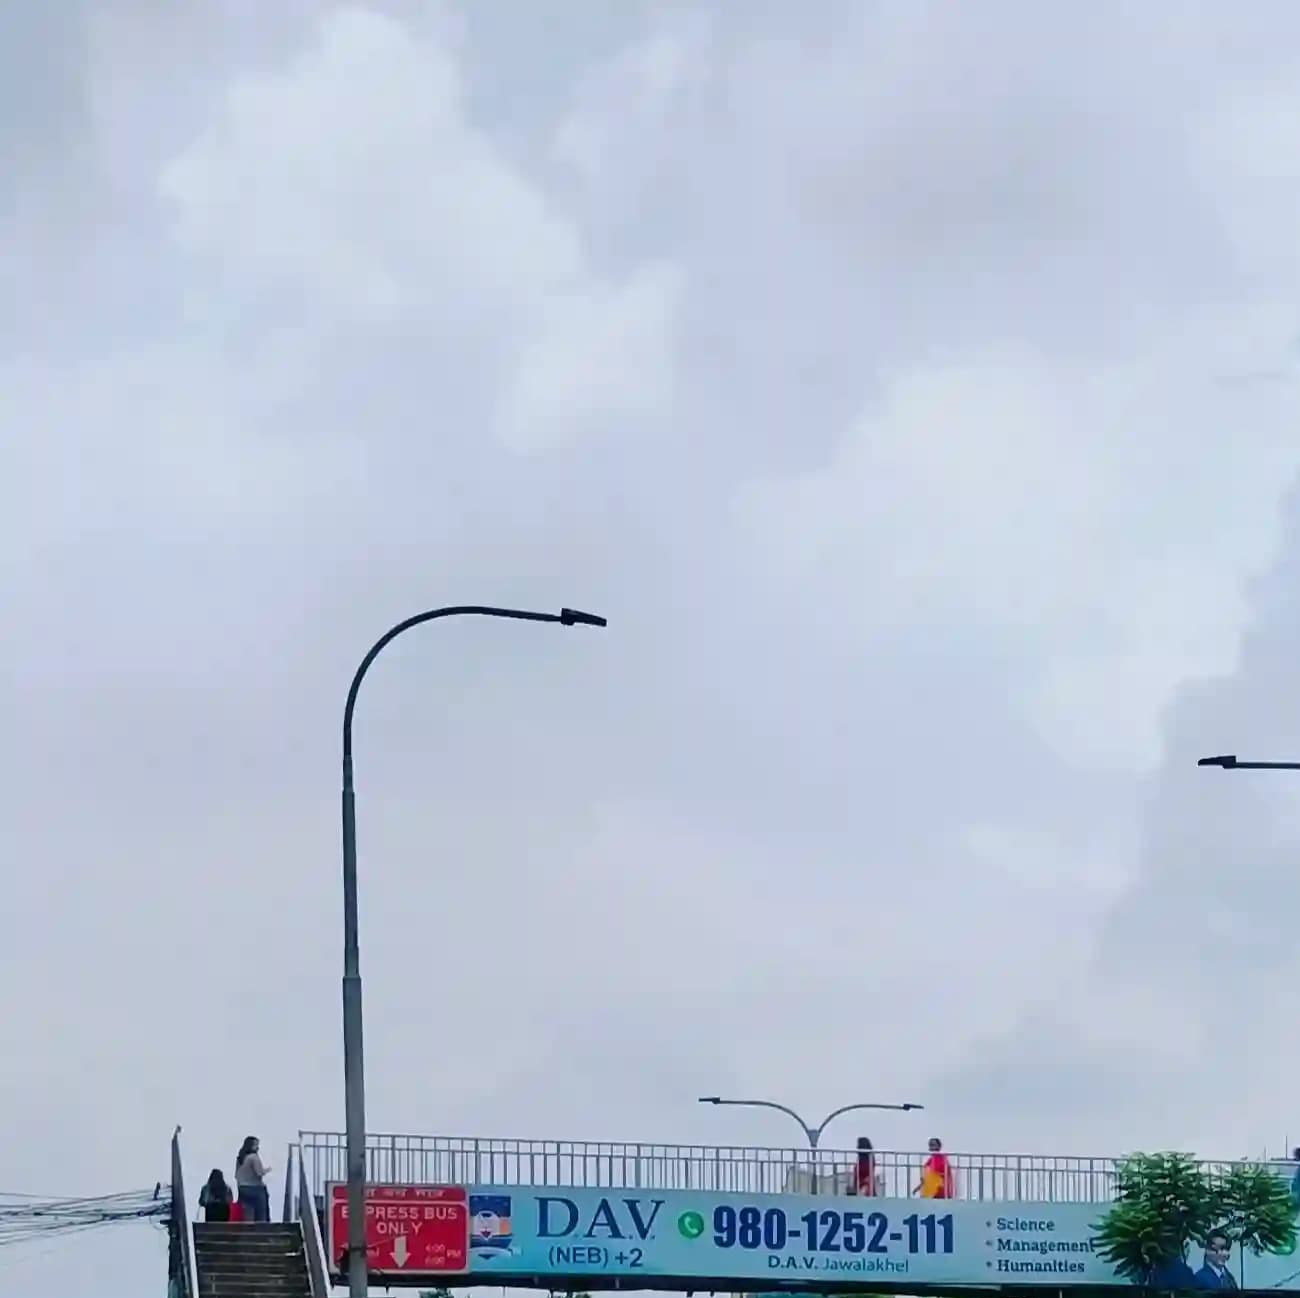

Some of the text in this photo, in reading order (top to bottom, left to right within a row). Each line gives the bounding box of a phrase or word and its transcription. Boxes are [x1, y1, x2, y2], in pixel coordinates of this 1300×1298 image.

[341, 1206, 457, 1220] EPRESS BUS
[376, 1222, 422, 1235] ONLY
[714, 1205, 954, 1254] 980-1252-111
[997, 1218, 1055, 1231] Science
[997, 1238, 1096, 1255] Management
[549, 1246, 643, 1268] (NEB) +2
[768, 1255, 909, 1273] D.A.V. Jawalakhel
[997, 1259, 1085, 1273] Humanities
